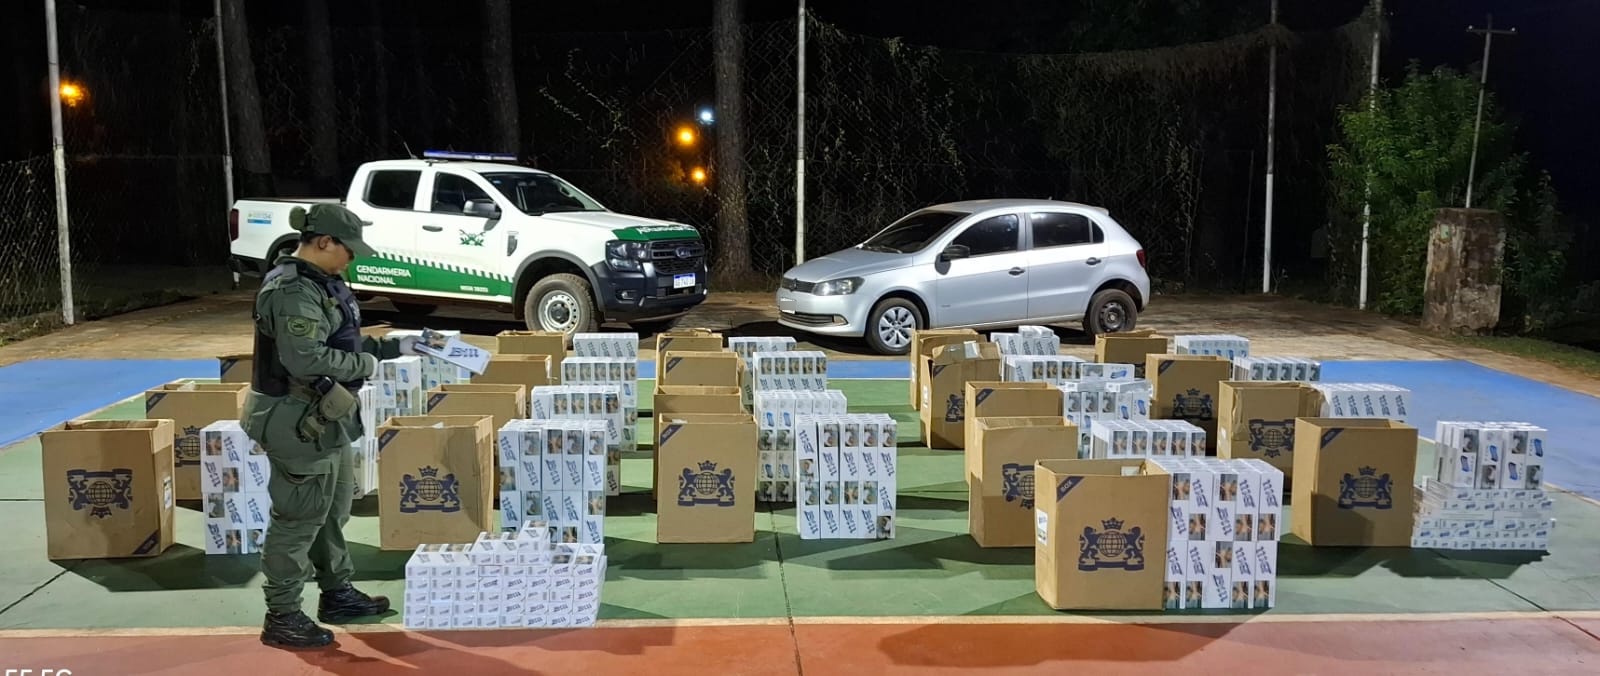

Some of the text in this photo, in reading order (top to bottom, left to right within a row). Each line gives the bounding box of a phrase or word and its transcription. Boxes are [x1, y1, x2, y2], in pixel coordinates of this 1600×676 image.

[356, 265, 411, 278] GENDARMERIA
[357, 275, 396, 285] NACIONAL
[1060, 481, 1073, 492] BOX
